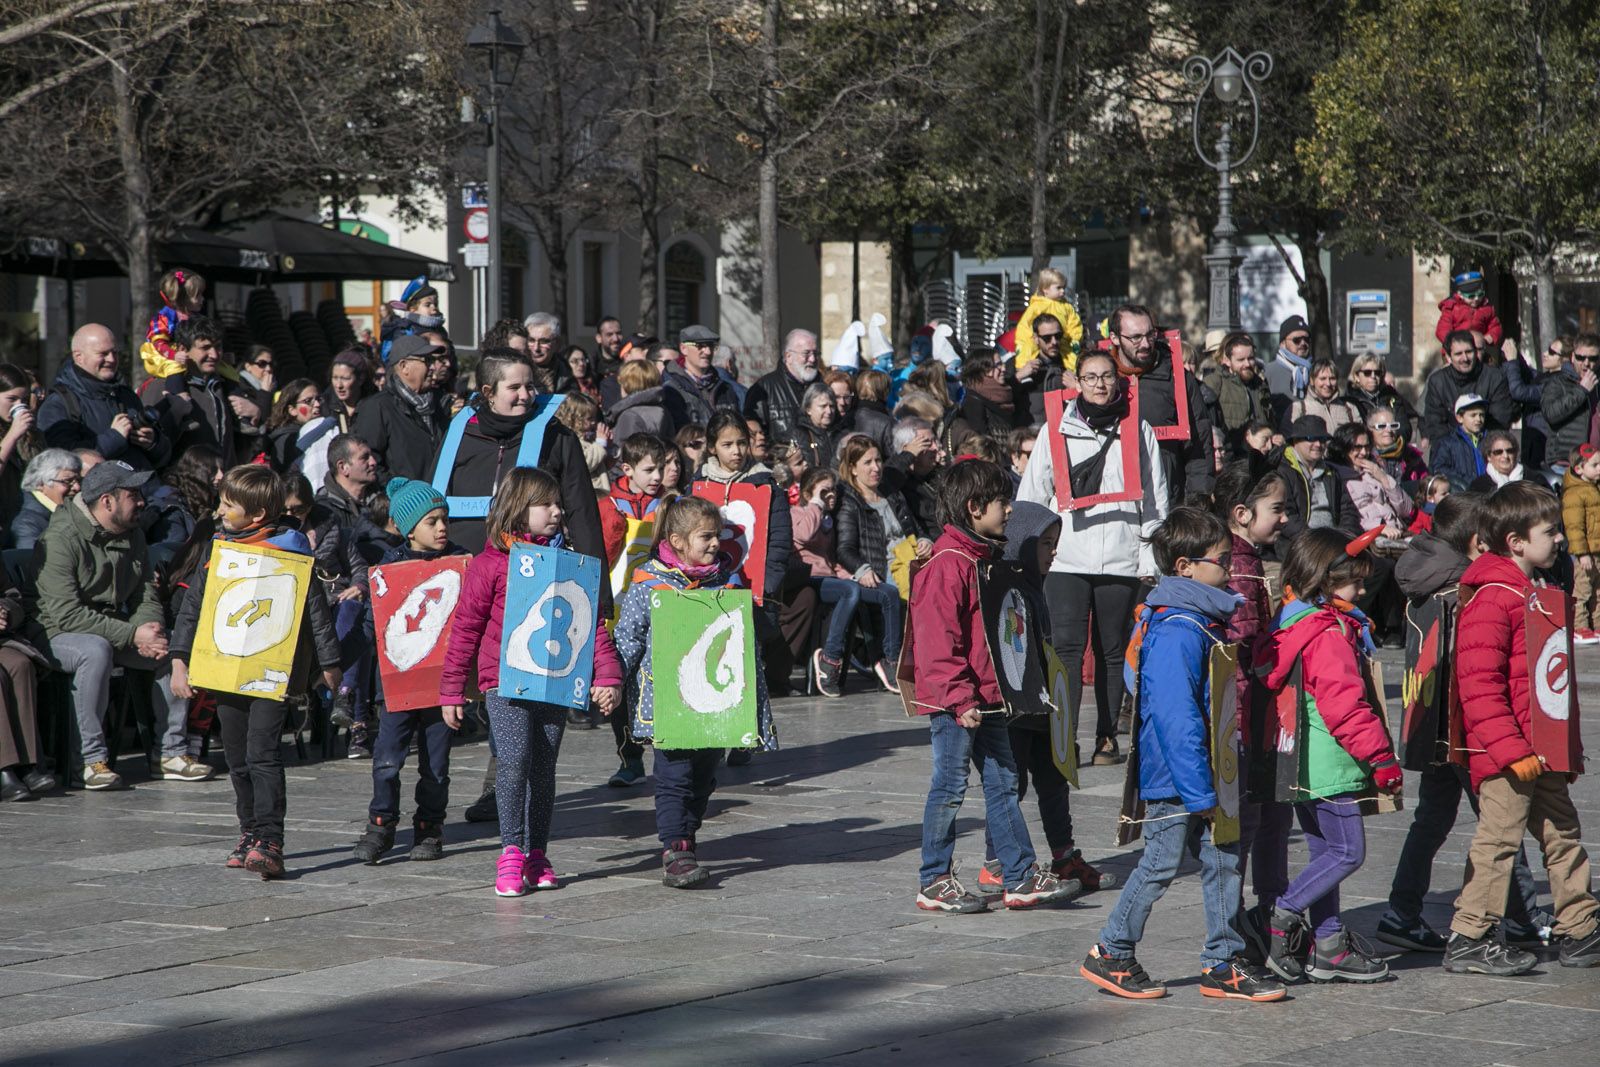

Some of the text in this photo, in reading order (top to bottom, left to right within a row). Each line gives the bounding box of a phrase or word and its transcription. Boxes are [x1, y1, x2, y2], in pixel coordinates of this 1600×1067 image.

[519, 554, 535, 578] 8
[651, 592, 661, 608] 6
[527, 595, 574, 671] 8
[573, 676, 585, 699] 8
